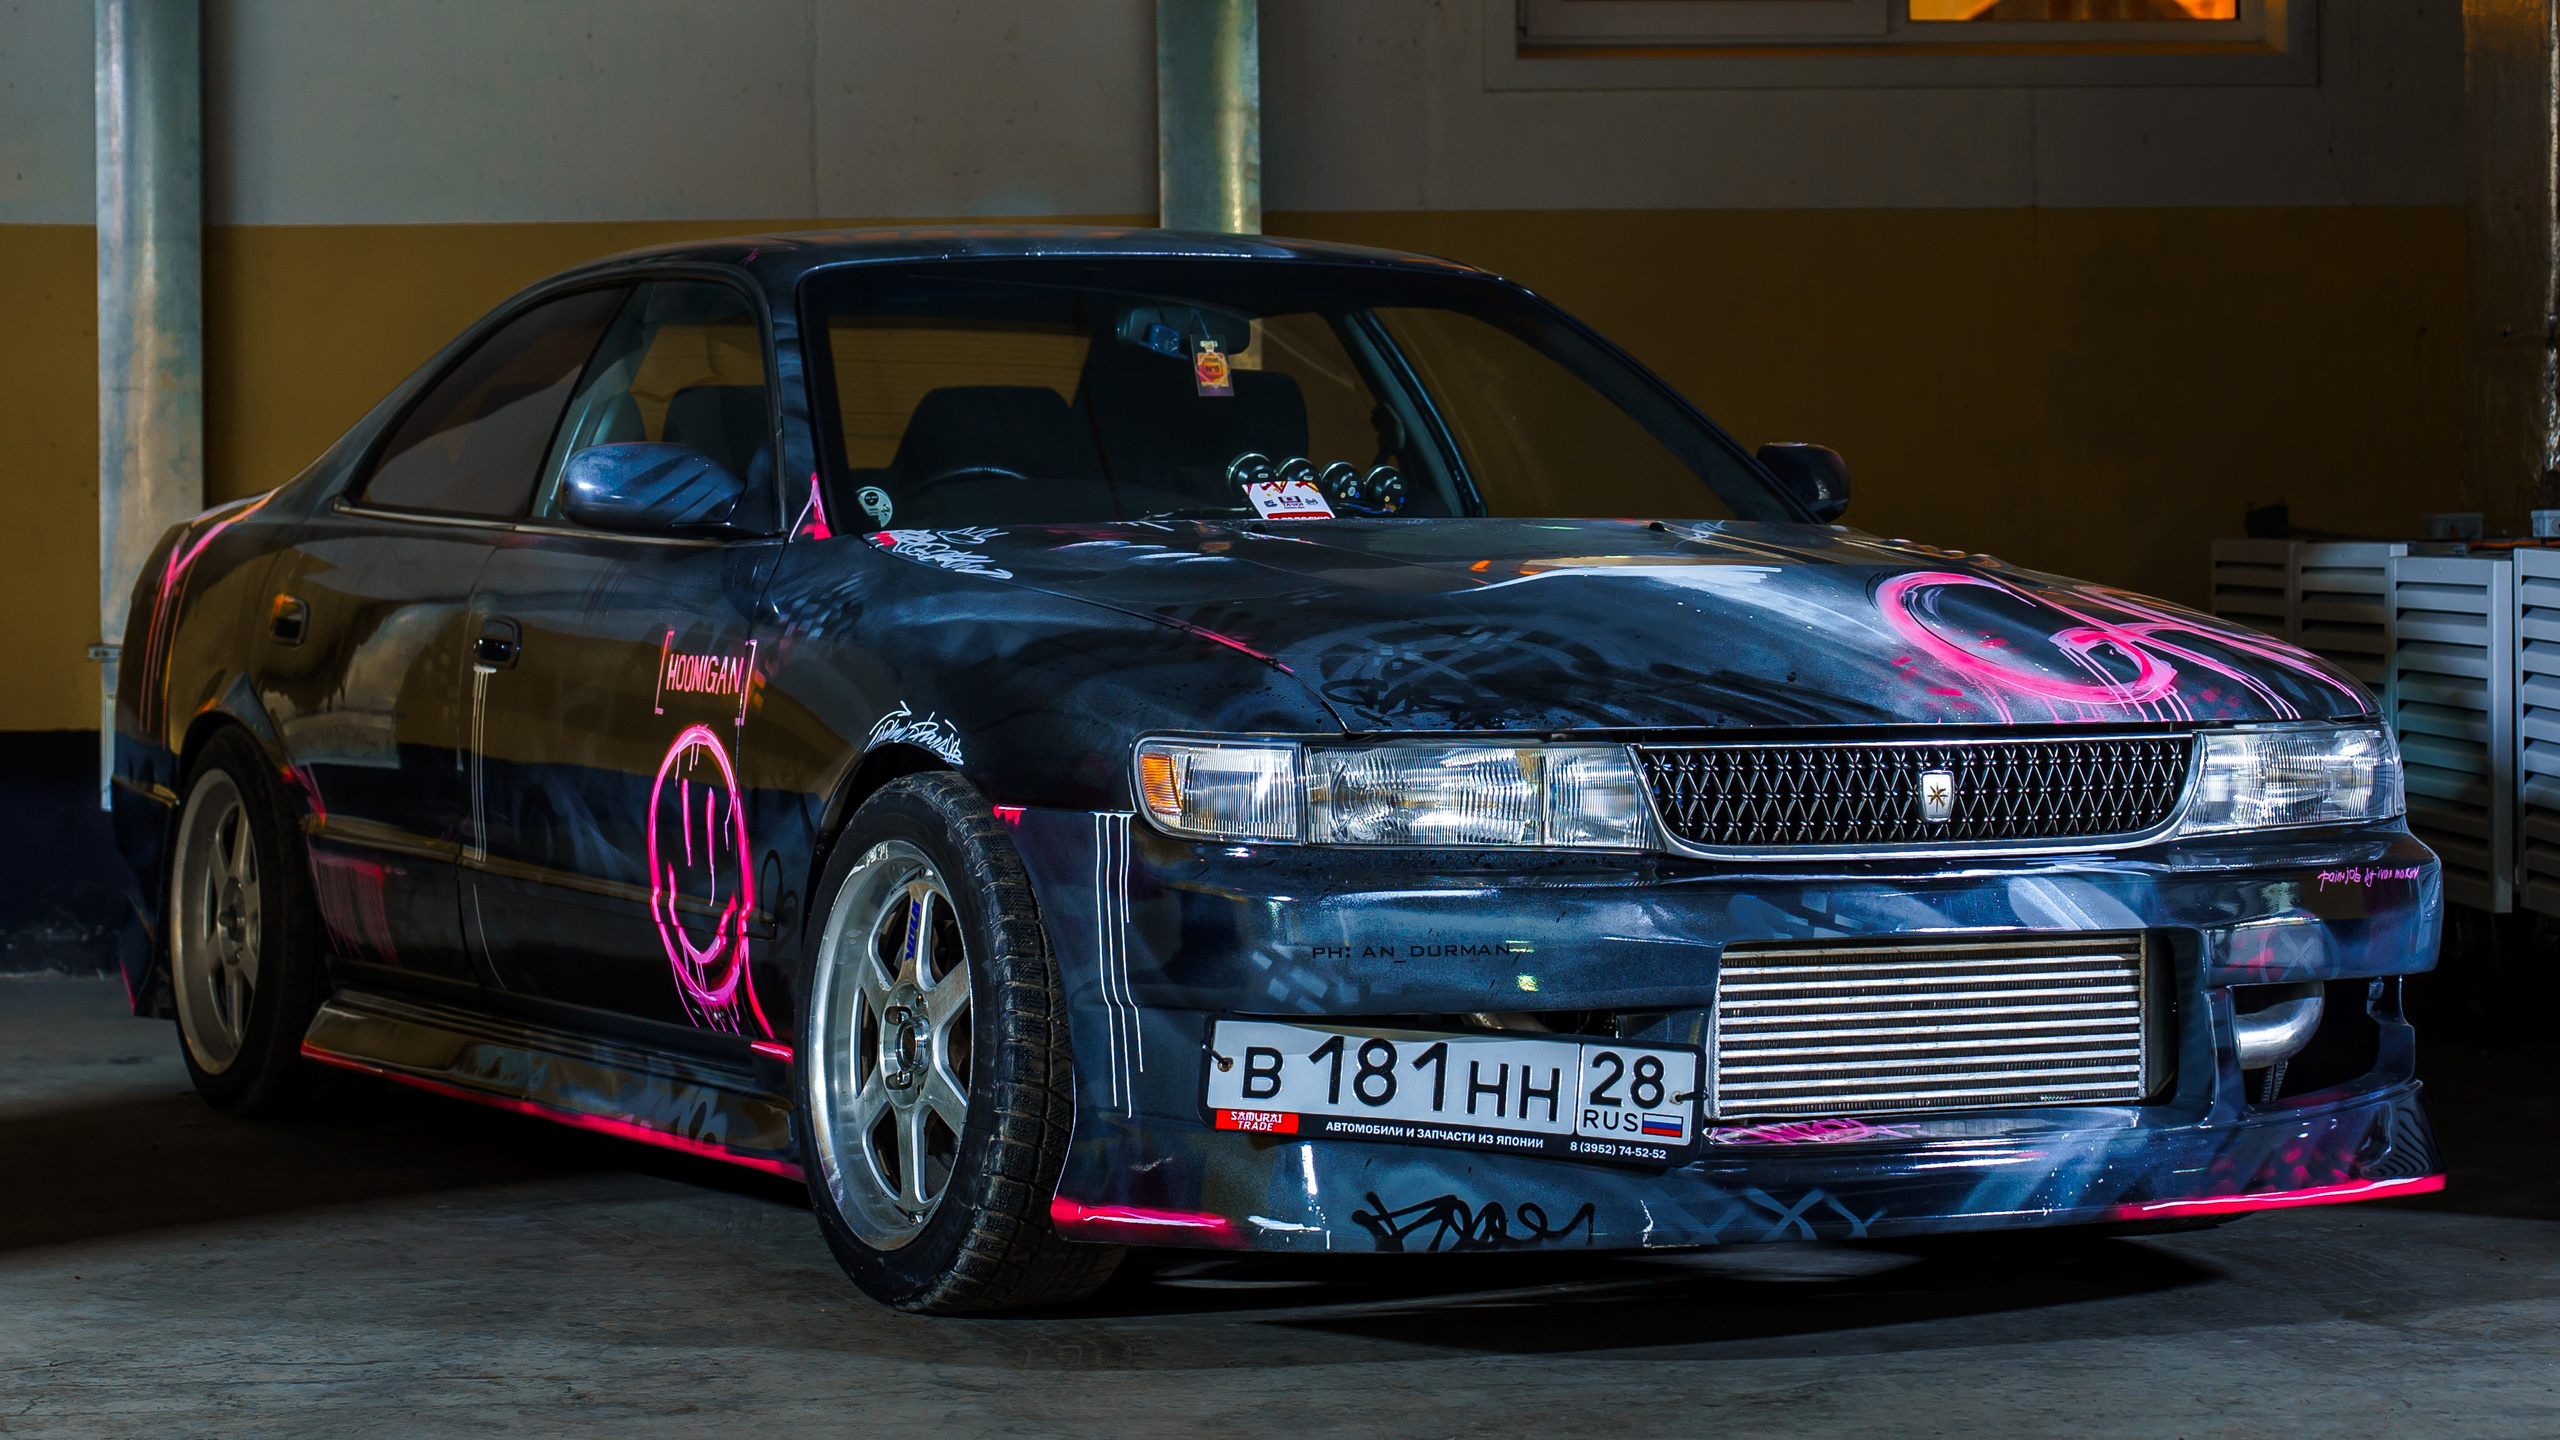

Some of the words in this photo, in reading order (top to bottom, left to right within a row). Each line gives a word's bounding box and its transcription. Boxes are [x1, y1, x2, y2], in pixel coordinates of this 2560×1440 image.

[1589, 1051, 1666, 1110] 28
[1230, 1111, 1284, 1124] SAMURAI
[1237, 1121, 1274, 1132] TRADE
[1582, 1109, 1639, 1133] RUS
[1325, 1121, 1404, 1137] АВТОМОБИЛИ
[1406, 1128, 1415, 1138] И
[1416, 1128, 1476, 1143] ЗАПЧАСТИ
[1478, 1133, 1494, 1144] ИЗ
[1496, 1135, 1545, 1149] ЯПОНИИ
[1570, 1141, 1578, 1151] 8
[1580, 1141, 1617, 1156] (3952)
[1619, 1145, 1668, 1160] 74-52-52
